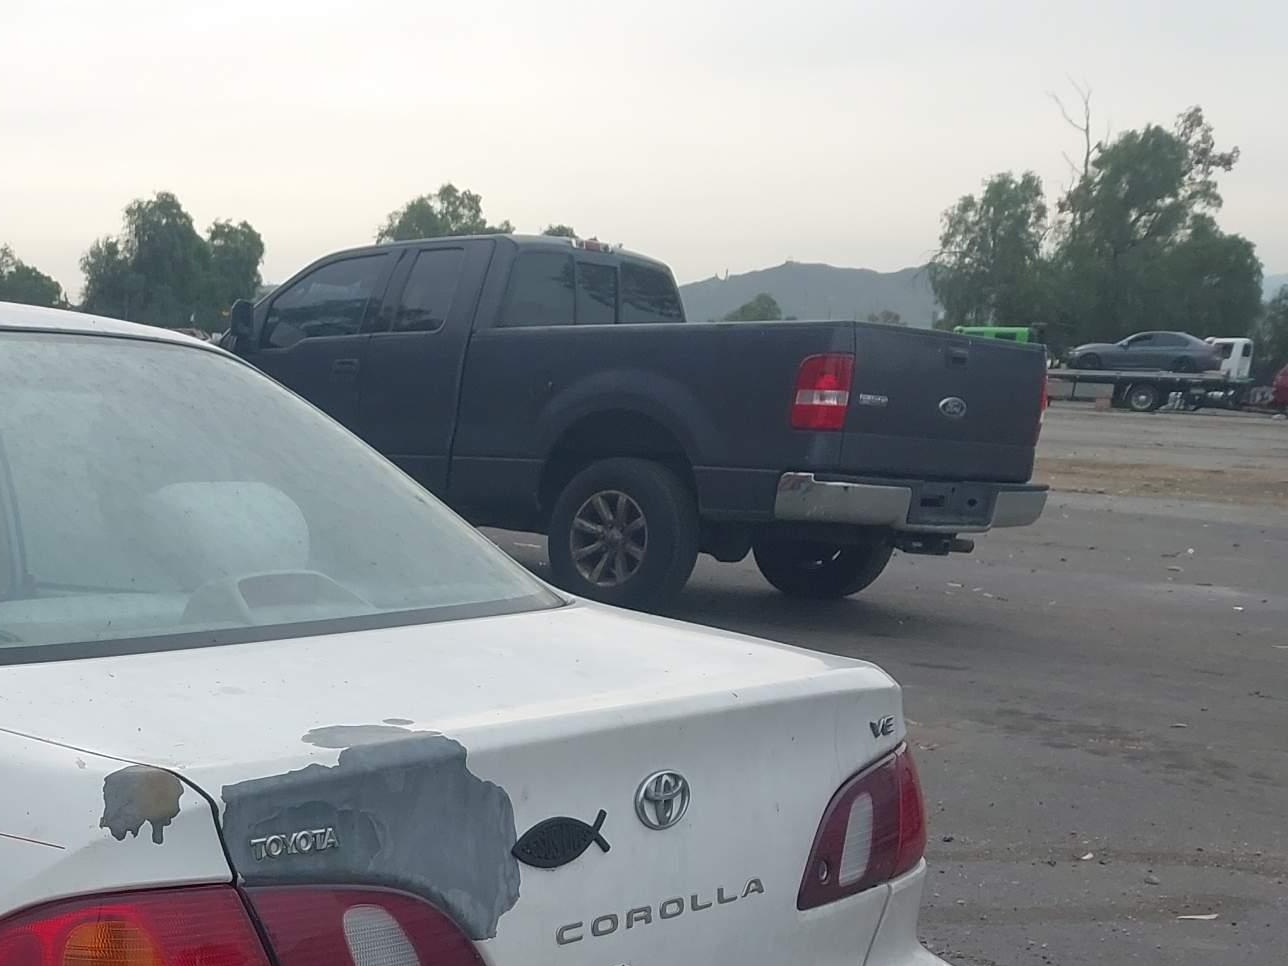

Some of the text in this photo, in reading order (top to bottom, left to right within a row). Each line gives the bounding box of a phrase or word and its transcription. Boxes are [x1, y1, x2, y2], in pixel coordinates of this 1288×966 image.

[869, 715, 895, 738] VE
[250, 828, 339, 860] TOYOTA
[556, 878, 765, 945] COROLLA
